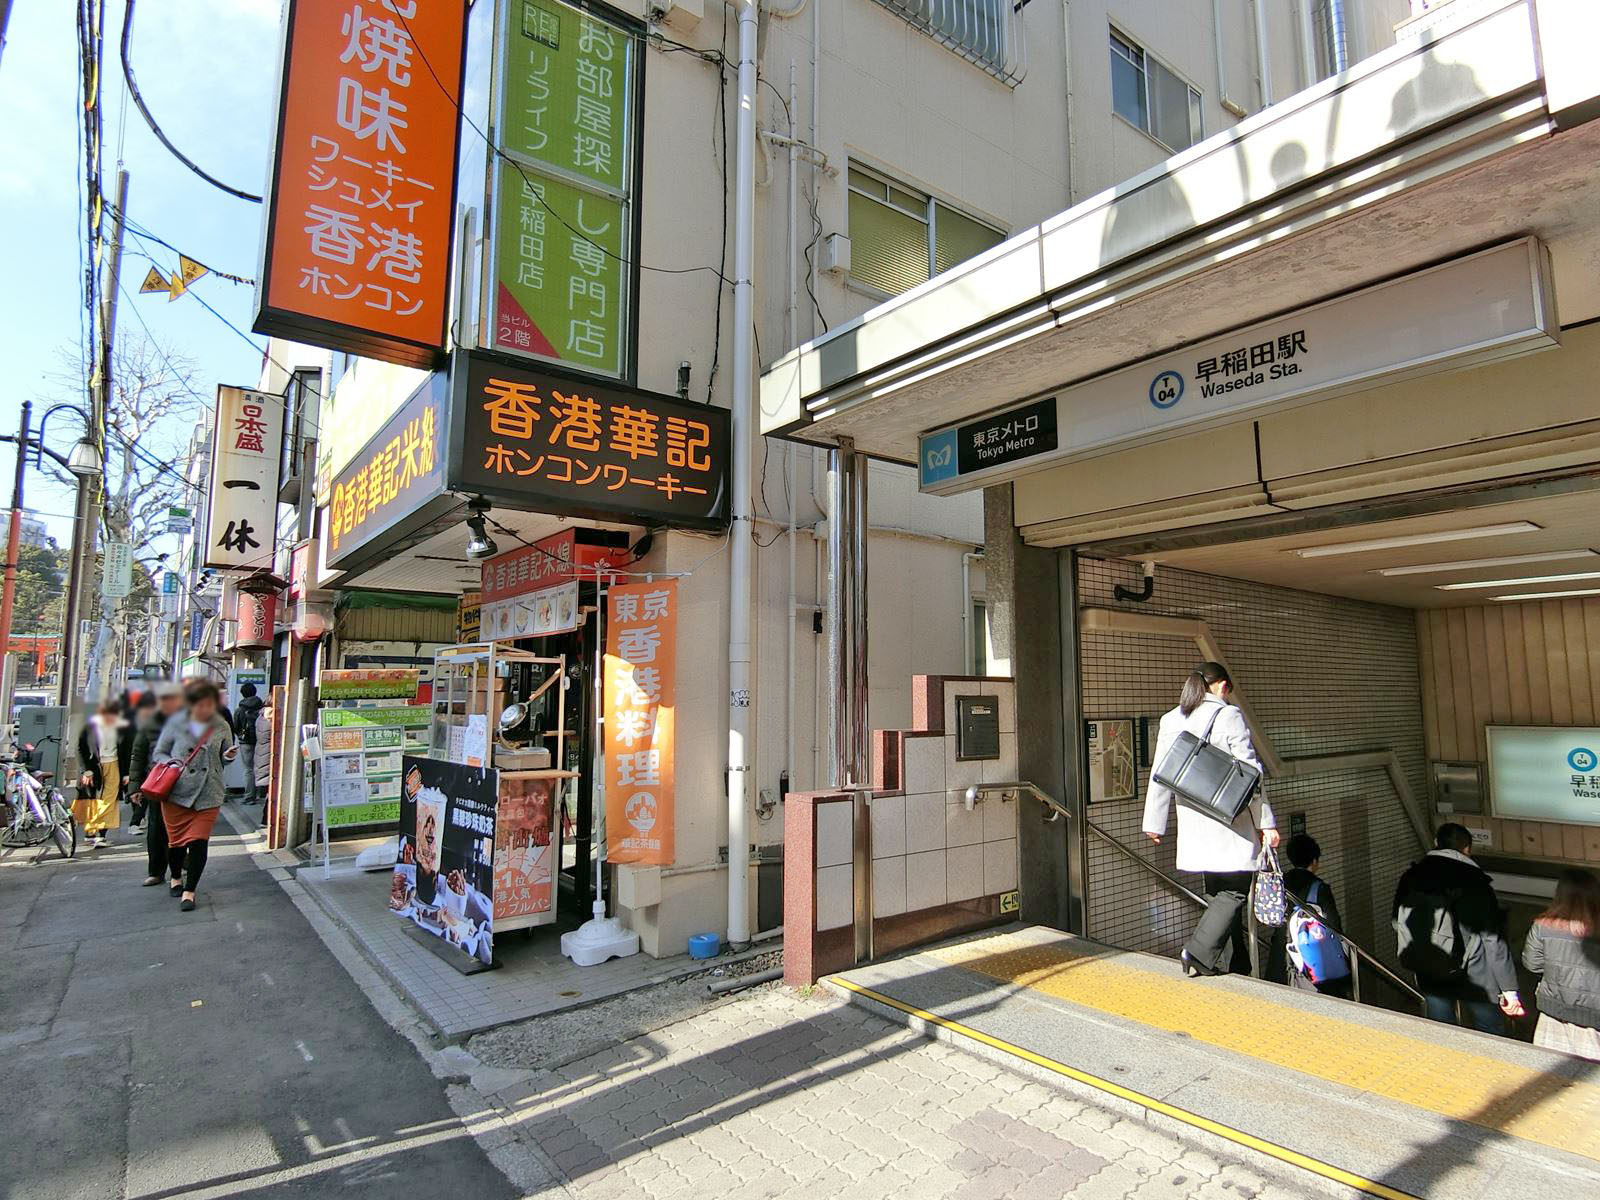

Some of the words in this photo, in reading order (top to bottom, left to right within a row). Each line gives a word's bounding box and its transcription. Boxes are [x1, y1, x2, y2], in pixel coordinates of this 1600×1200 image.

[338, 0, 417, 156] 焼味
[522, 48, 550, 150] リライフ
[309, 134, 436, 191] ワーキー
[567, 19, 613, 361] お部屋探し専門店
[306, 163, 427, 224] シュメイ
[303, 203, 425, 285] 香港
[517, 179, 546, 290] 早稲田店
[298, 265, 425, 317] ホンコン
[1162, 377, 1170, 388] T
[1195, 330, 1309, 382] 早稲田駅
[1200, 370, 1265, 399] Waseda
[1269, 362, 1304, 380] Sta.
[1157, 386, 1176, 402] 04
[234, 404, 268, 454] 日本盛
[483, 376, 713, 473] 香港華記
[973, 415, 1040, 448] 東京メトロ
[976, 444, 1004, 461] Tokyo
[1005, 435, 1036, 453] Metro
[484, 443, 708, 501] ホンコンワーキー
[216, 479, 261, 554] 一休
[614, 589, 671, 624] 東京
[614, 624, 662, 787] 香港料理
